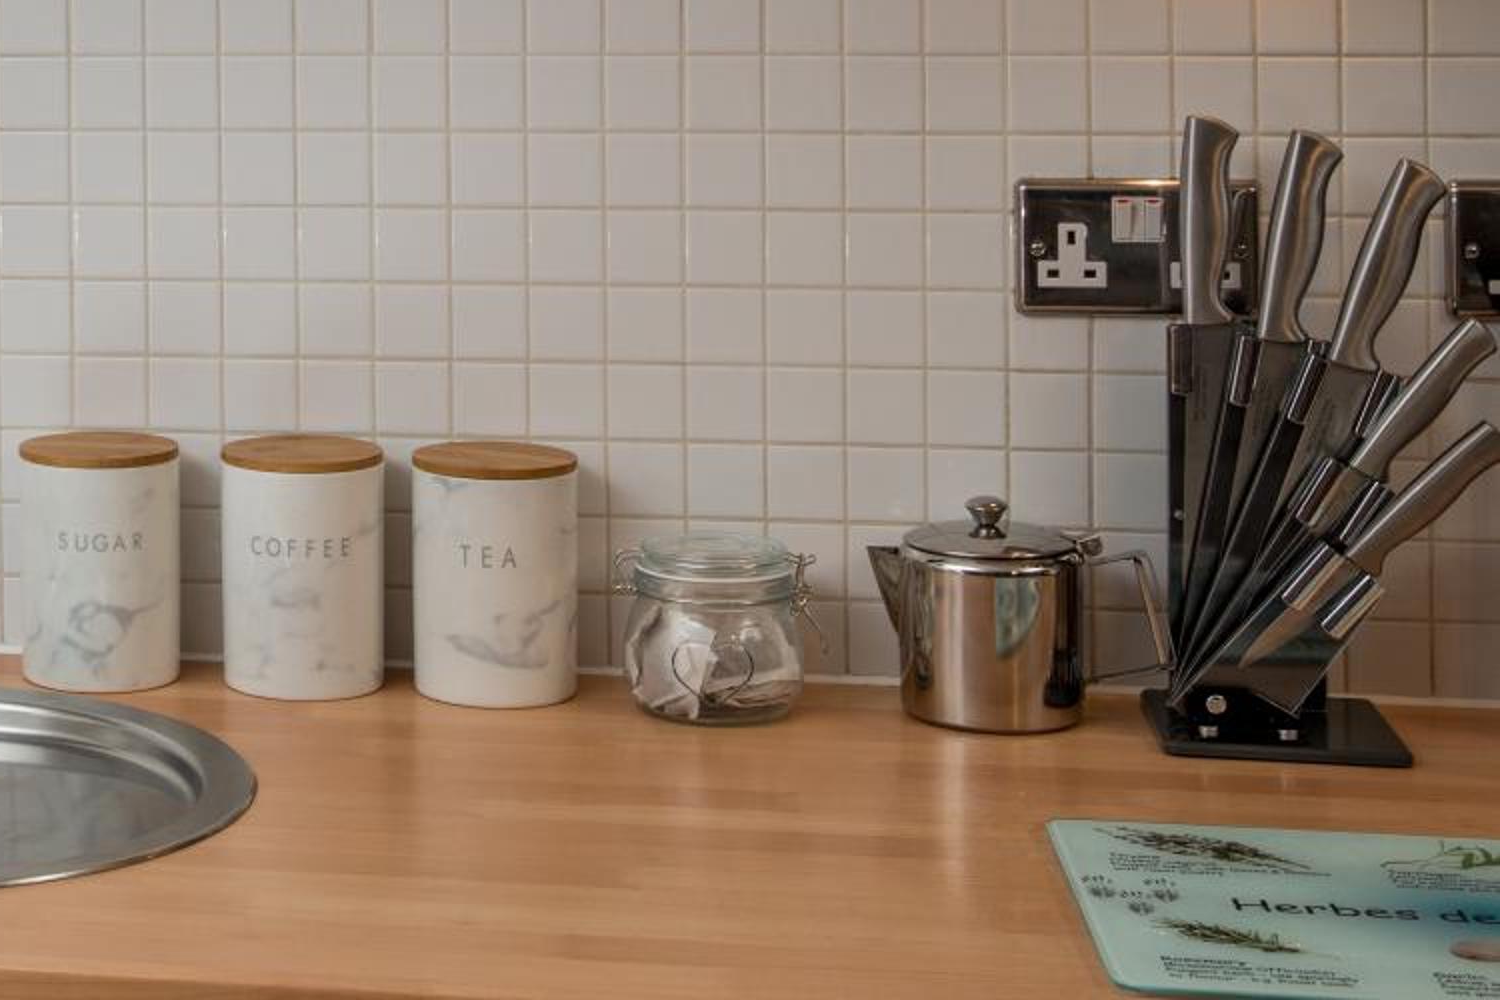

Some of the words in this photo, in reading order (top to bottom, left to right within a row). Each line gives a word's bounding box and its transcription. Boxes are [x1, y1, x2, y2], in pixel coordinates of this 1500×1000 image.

[57, 530, 145, 553] SUGAR
[250, 534, 351, 559] COFFEE
[458, 543, 517, 569] TEA
[1231, 896, 1421, 922] Herbes
